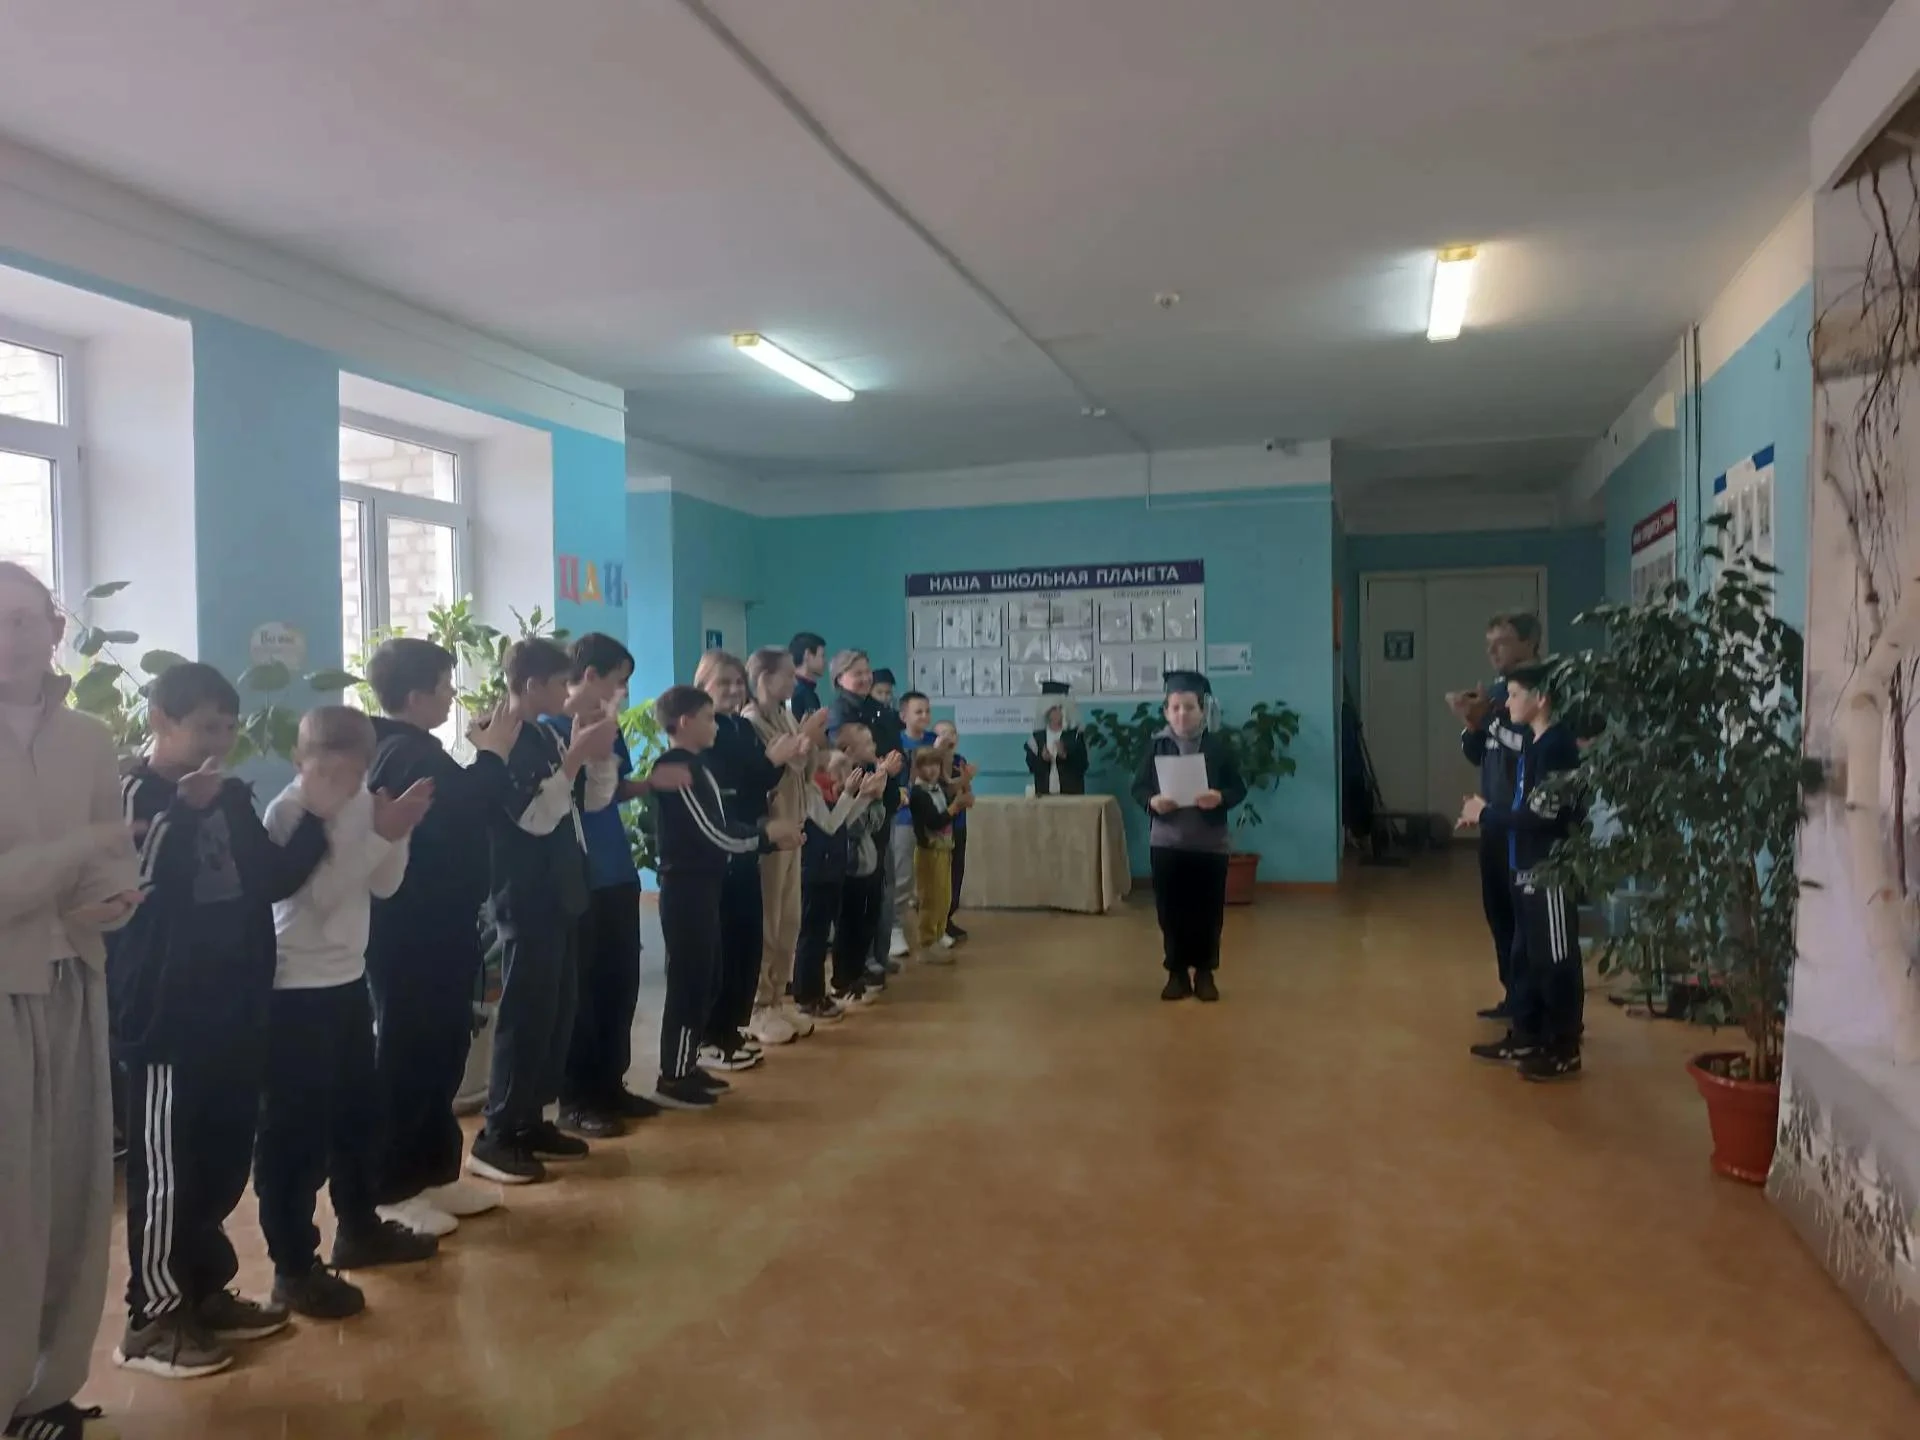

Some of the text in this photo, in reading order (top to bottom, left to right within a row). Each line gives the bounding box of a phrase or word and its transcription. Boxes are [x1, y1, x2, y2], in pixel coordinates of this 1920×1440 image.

[929, 564, 1180, 593] НАША ШКОЛЬНАЯ ПЛАНЕТА
